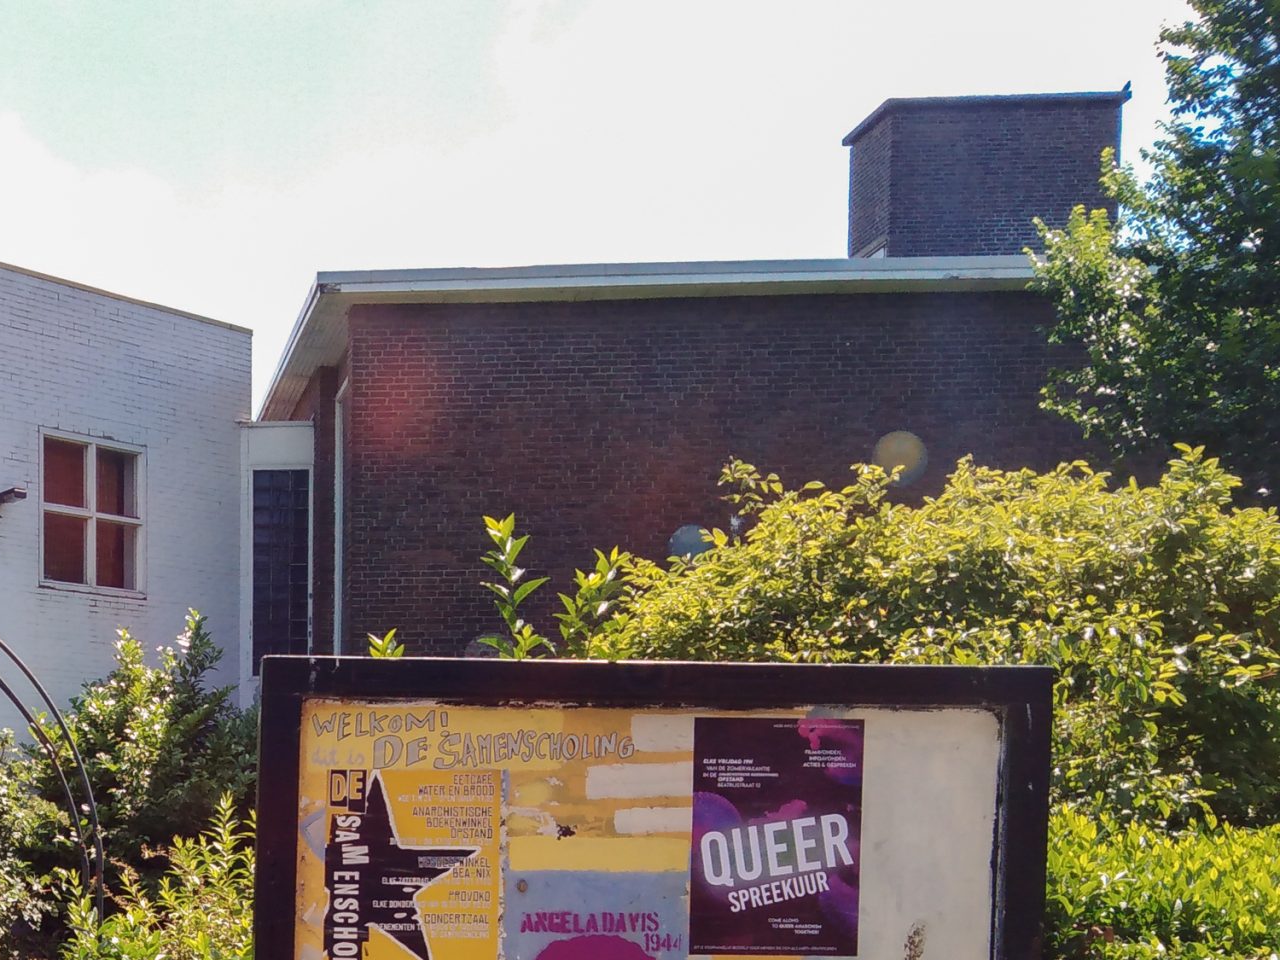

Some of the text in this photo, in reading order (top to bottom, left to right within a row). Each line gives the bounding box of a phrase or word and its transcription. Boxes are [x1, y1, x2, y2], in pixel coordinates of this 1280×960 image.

[312, 710, 448, 741] WELKOM!
[373, 729, 635, 769] DE SAMENSCHOLING
[331, 771, 363, 801] DE
[449, 786, 459, 796] EN
[464, 786, 494, 796] BROOD
[413, 806, 492, 817] ANARCHISTISCHE
[426, 817, 492, 828] BOEKENWINKEL
[451, 828, 492, 839] OPSTAND
[700, 813, 854, 887] QUEER
[453, 868, 490, 878] BEA-NIX
[448, 891, 490, 901] PROVOKO
[728, 872, 830, 913] SPREEKUUR
[424, 914, 489, 924] CONCERTZAAL
[643, 932, 682, 951] 1944
